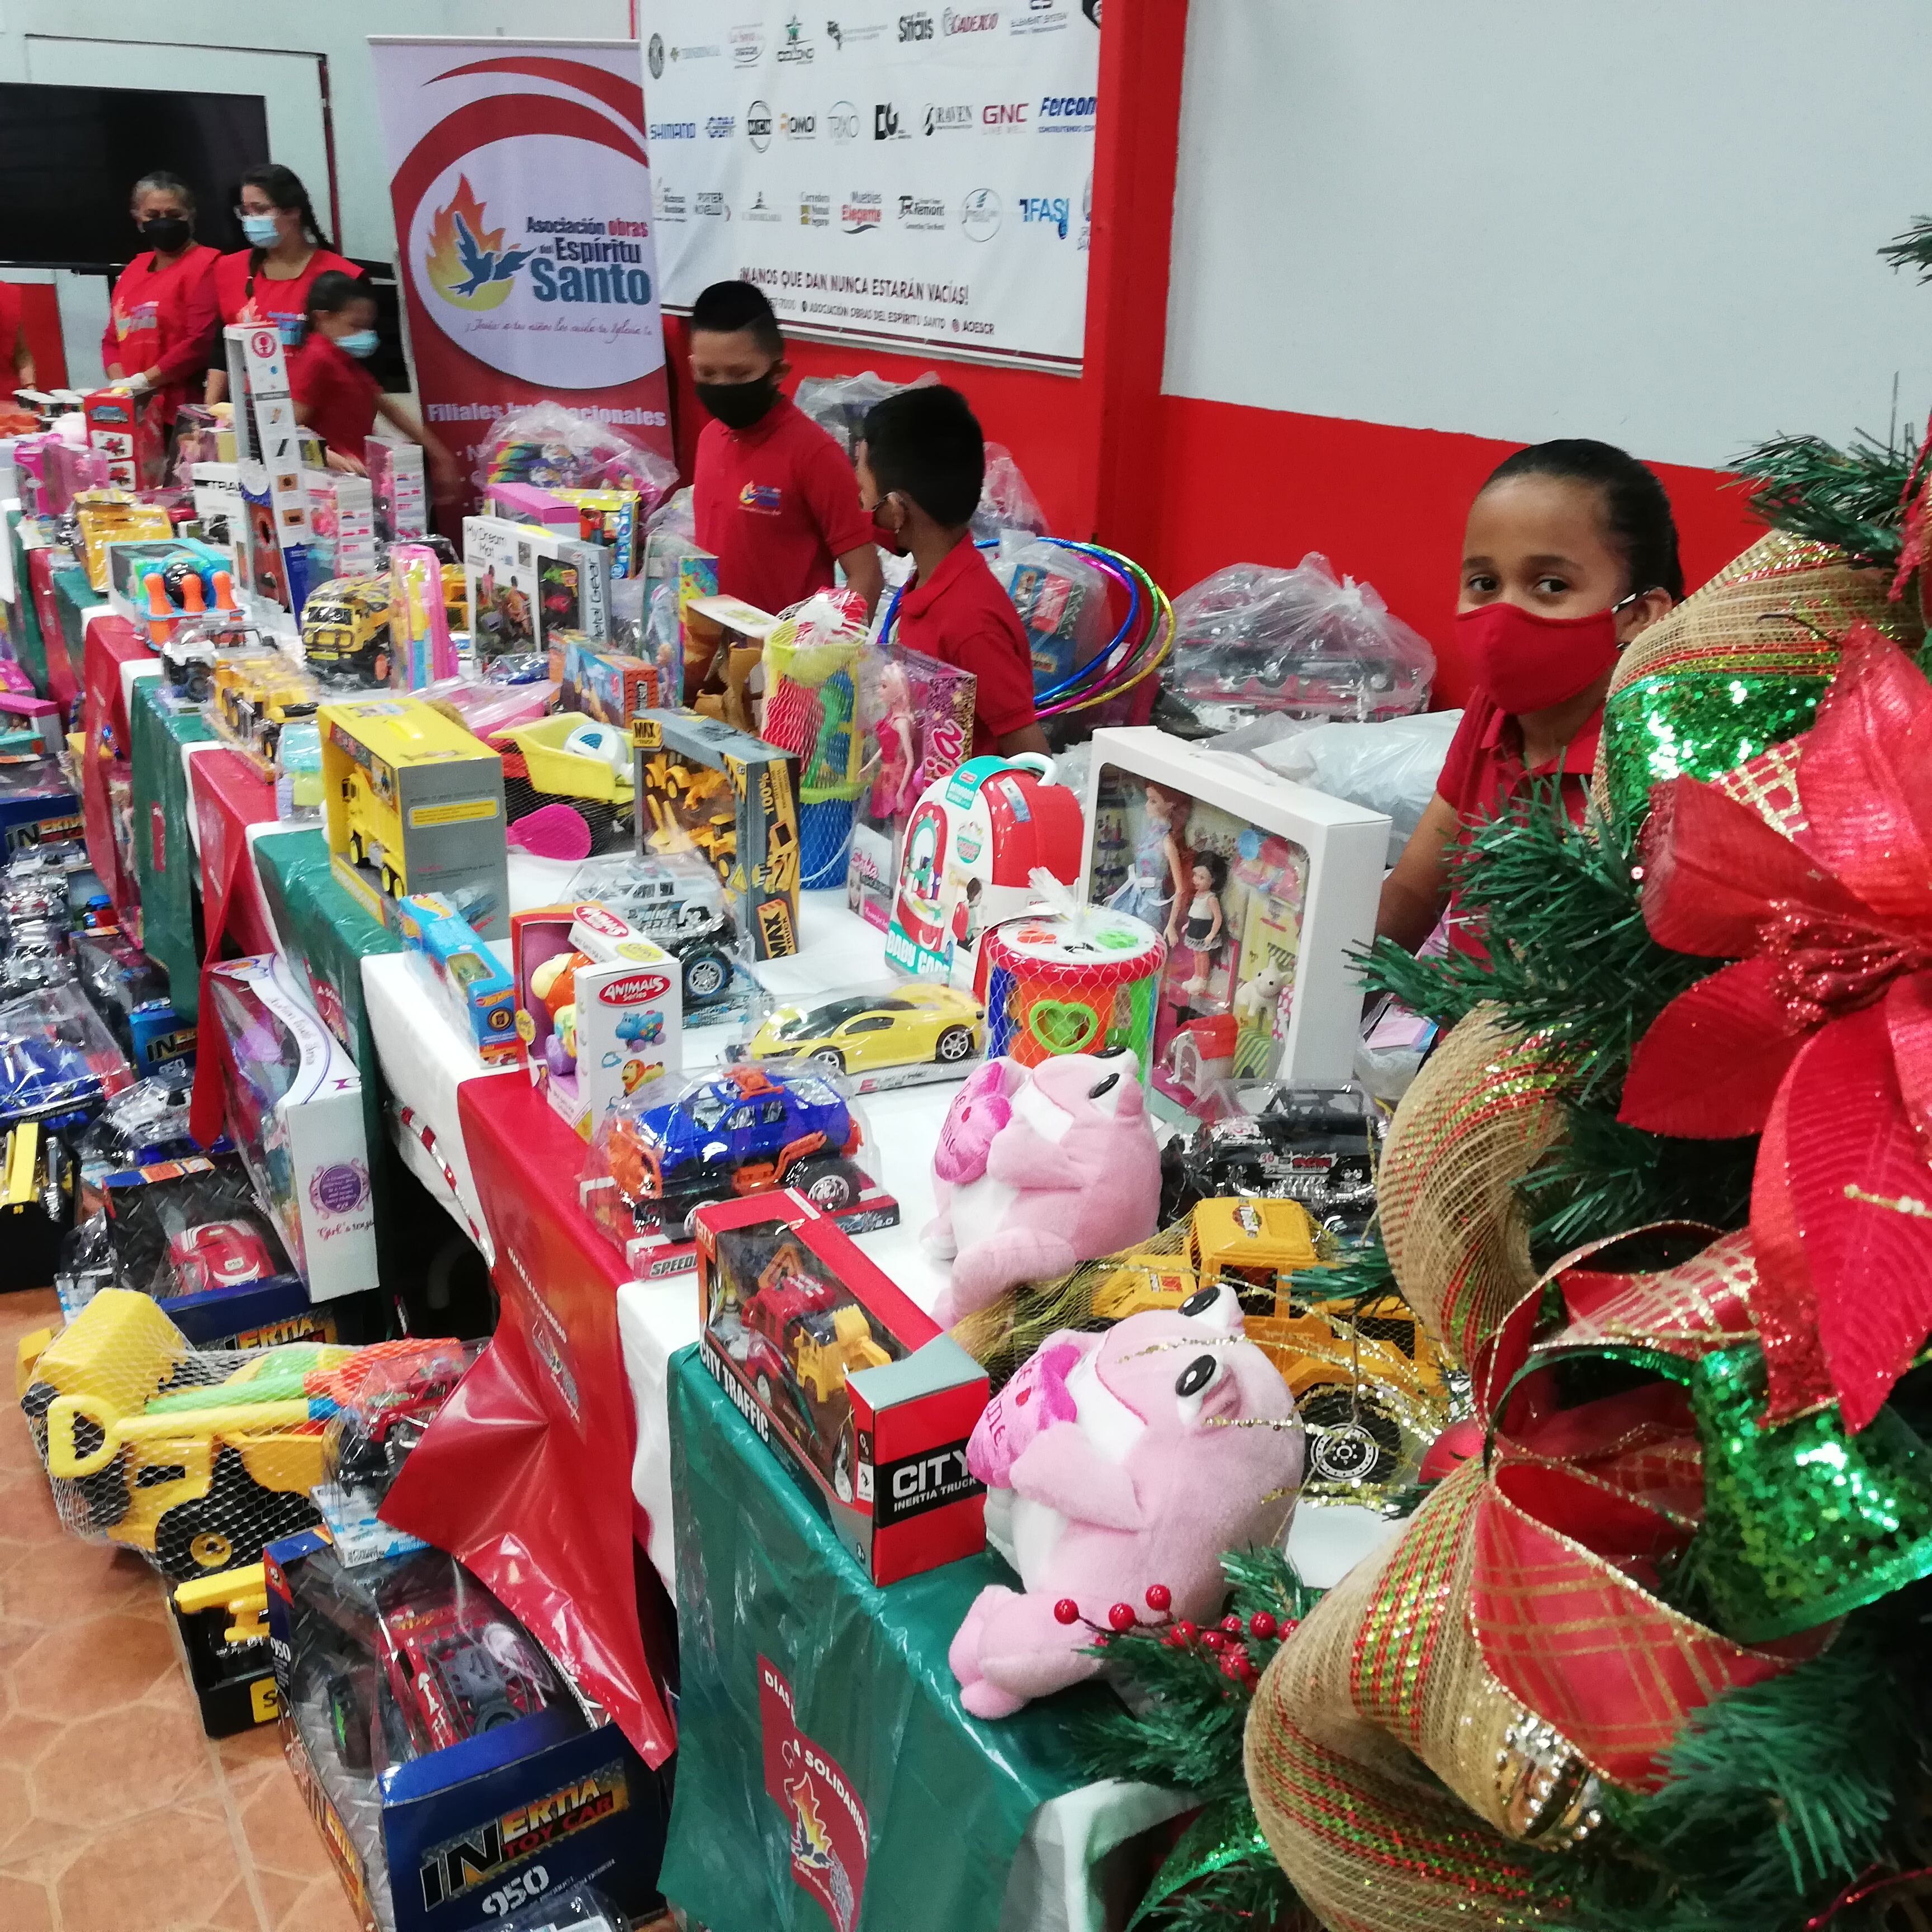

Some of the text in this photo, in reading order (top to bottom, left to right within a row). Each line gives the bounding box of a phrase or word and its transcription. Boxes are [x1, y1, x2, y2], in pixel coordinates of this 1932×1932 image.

[983, 103, 1029, 124] GNC
[525, 216, 648, 237] Asociación obras
[555, 236, 642, 263] Espíritu
[530, 257, 651, 305] Santo
[782, 271, 803, 288] QUE
[806, 272, 828, 291] DAN
[831, 275, 869, 295] NUNCA
[873, 277, 924, 301] ESTARÁN
[427, 402, 503, 422] Filiales
[756, 772, 775, 815] 100%
[763, 911, 788, 958] MAX
[603, 977, 664, 1001] ANIMALS
[700, 1338, 769, 1443] CITY TRAFFIC
[893, 1449, 969, 1499] CITY
[894, 1477, 977, 1512] INERTIA TRUCK
[419, 1778, 599, 1913] INERTIA
[503, 1794, 614, 1860] TOY CAR
[481, 1864, 550, 1917] 950
